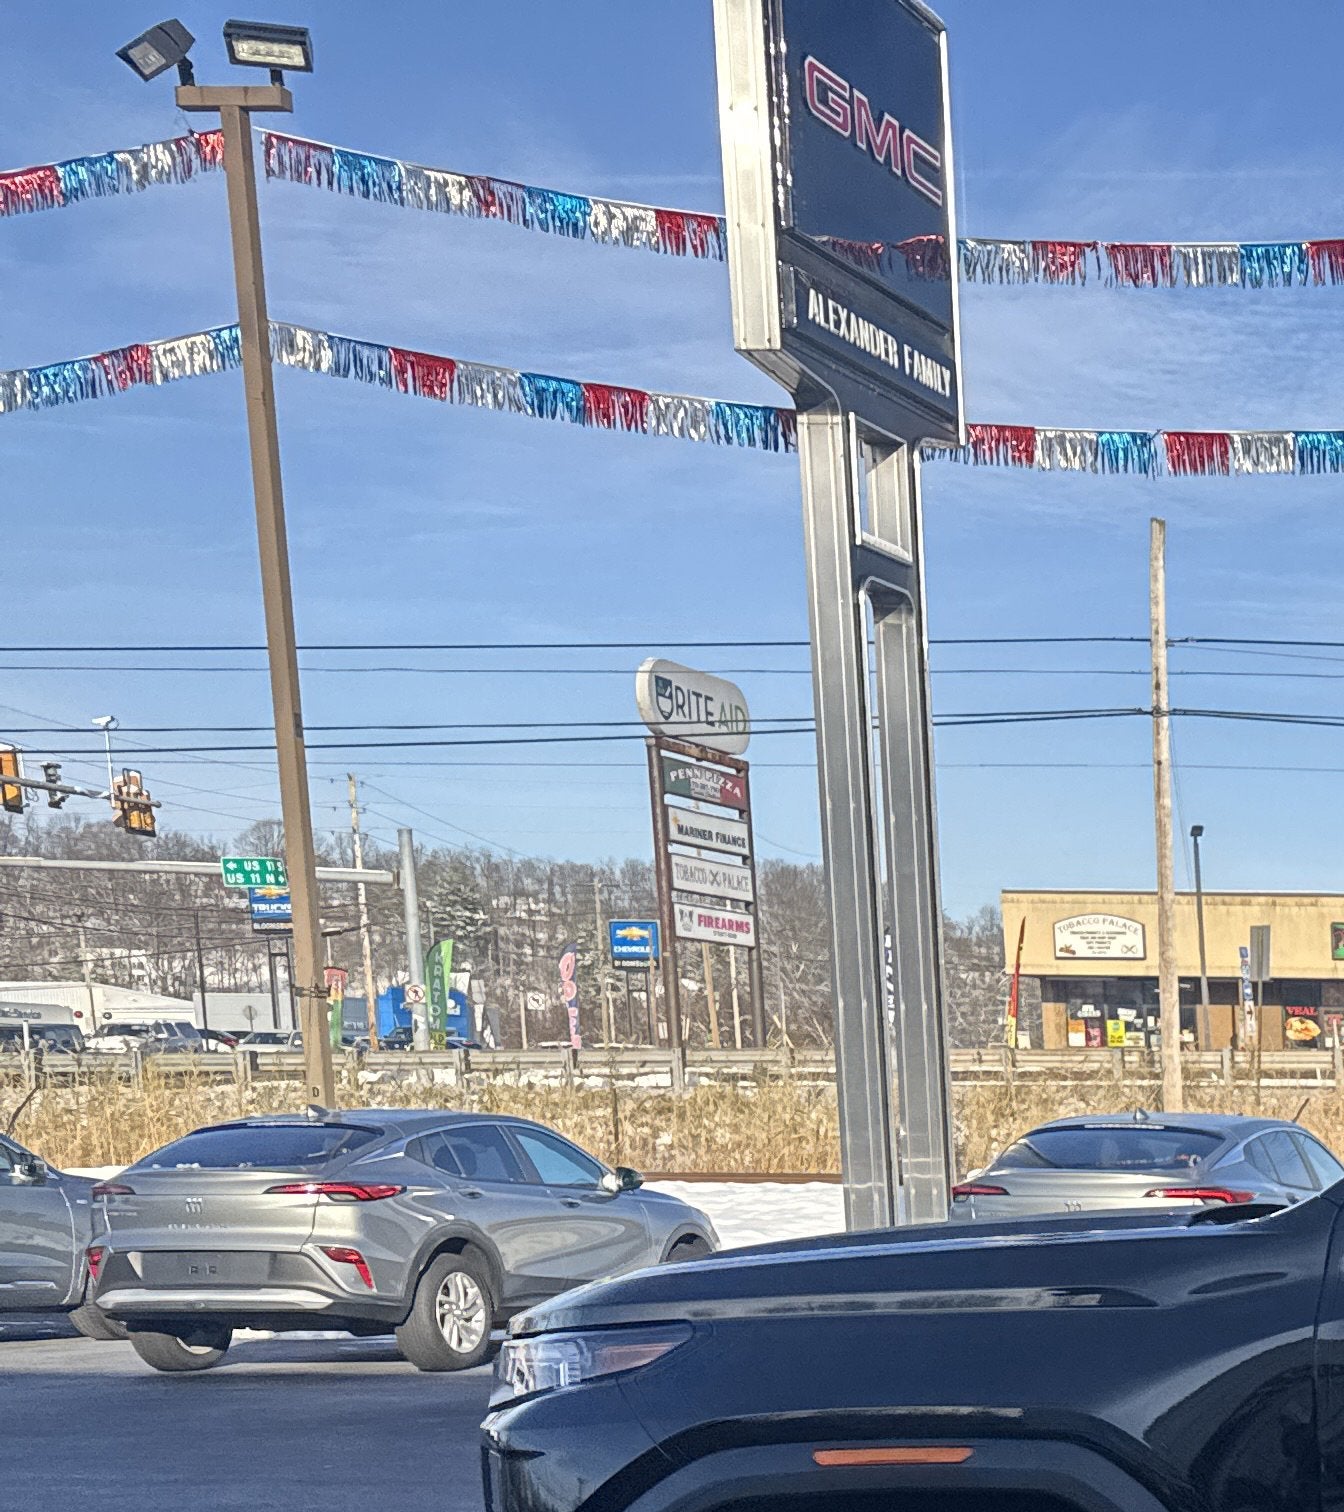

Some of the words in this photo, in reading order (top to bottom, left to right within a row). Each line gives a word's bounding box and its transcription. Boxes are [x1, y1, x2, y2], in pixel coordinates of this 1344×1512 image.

[804, 55, 943, 207] GMC
[807, 288, 900, 370] ALEXANDER
[903, 346, 951, 398] FAMILY
[675, 686, 715, 727] RITE
[717, 700, 746, 732] AID
[670, 768, 700, 782] PENN
[705, 771, 742, 798] PIZZA
[677, 824, 713, 842] MARINER
[244, 861, 260, 871] US
[227, 873, 244, 884] US
[250, 874, 261, 884] 11
[675, 863, 707, 885] TOBACCO
[722, 872, 750, 892] PALACE
[698, 914, 751, 935] FIREARMS
[1057, 917, 1100, 934] TOBACCO
[1102, 917, 1140, 936] PALACE
[1286, 1005, 1318, 1016] VEAL
